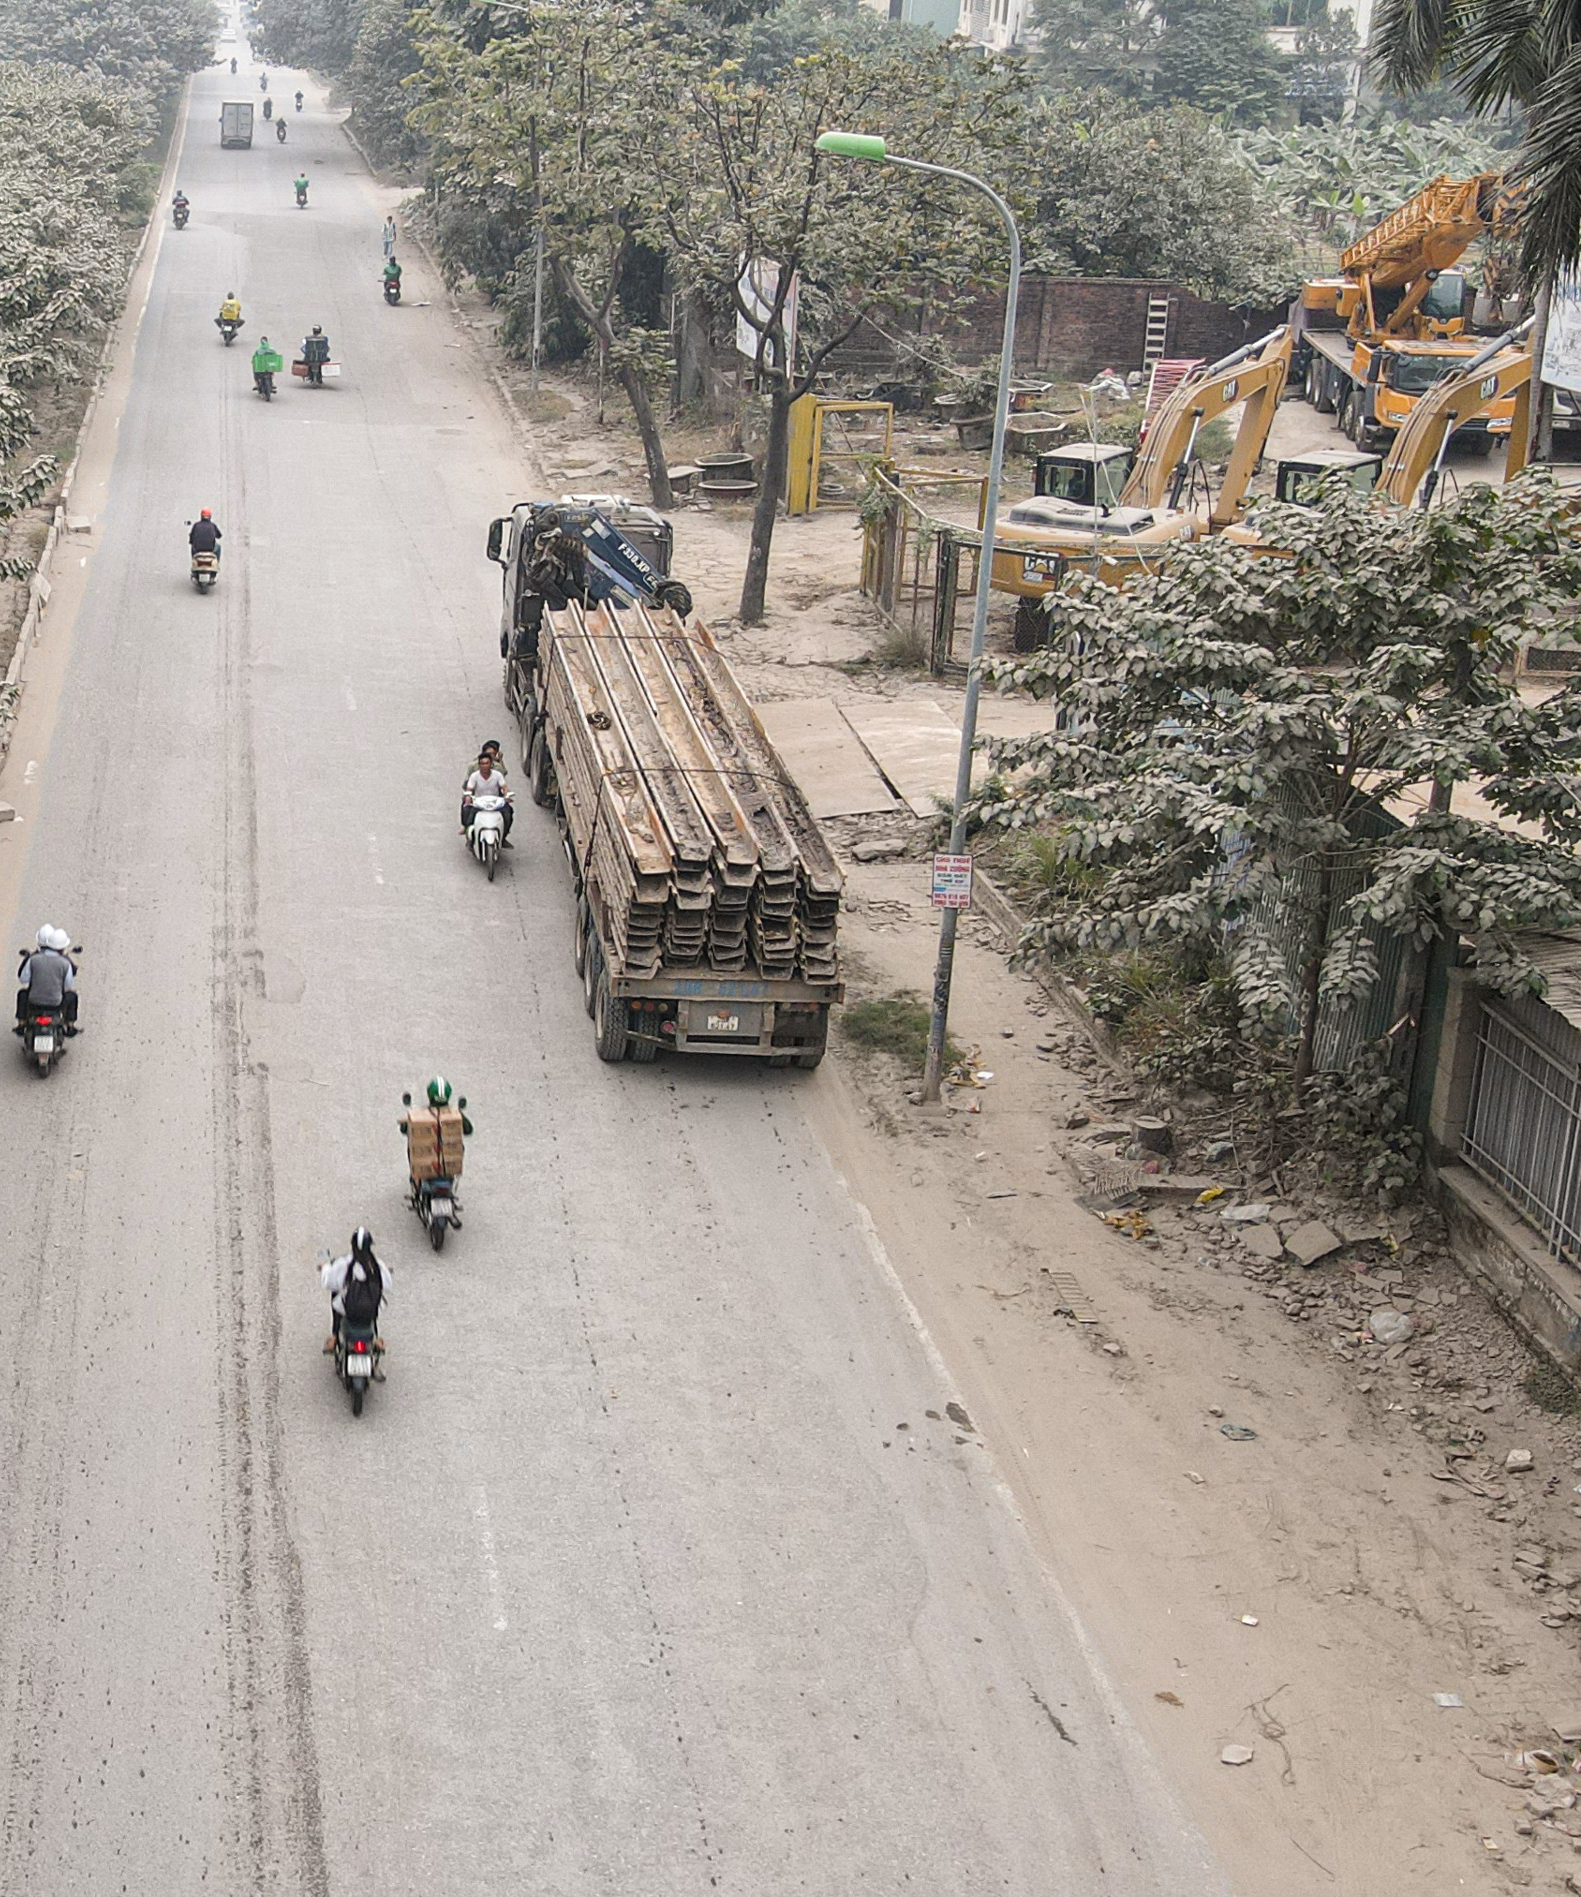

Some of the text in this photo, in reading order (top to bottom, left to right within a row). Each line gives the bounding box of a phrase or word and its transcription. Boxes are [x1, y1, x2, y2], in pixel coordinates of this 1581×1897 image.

[1222, 379, 1237, 402] CAT
[1480, 375, 1497, 400] CAT
[1024, 549, 1059, 574] CAT
